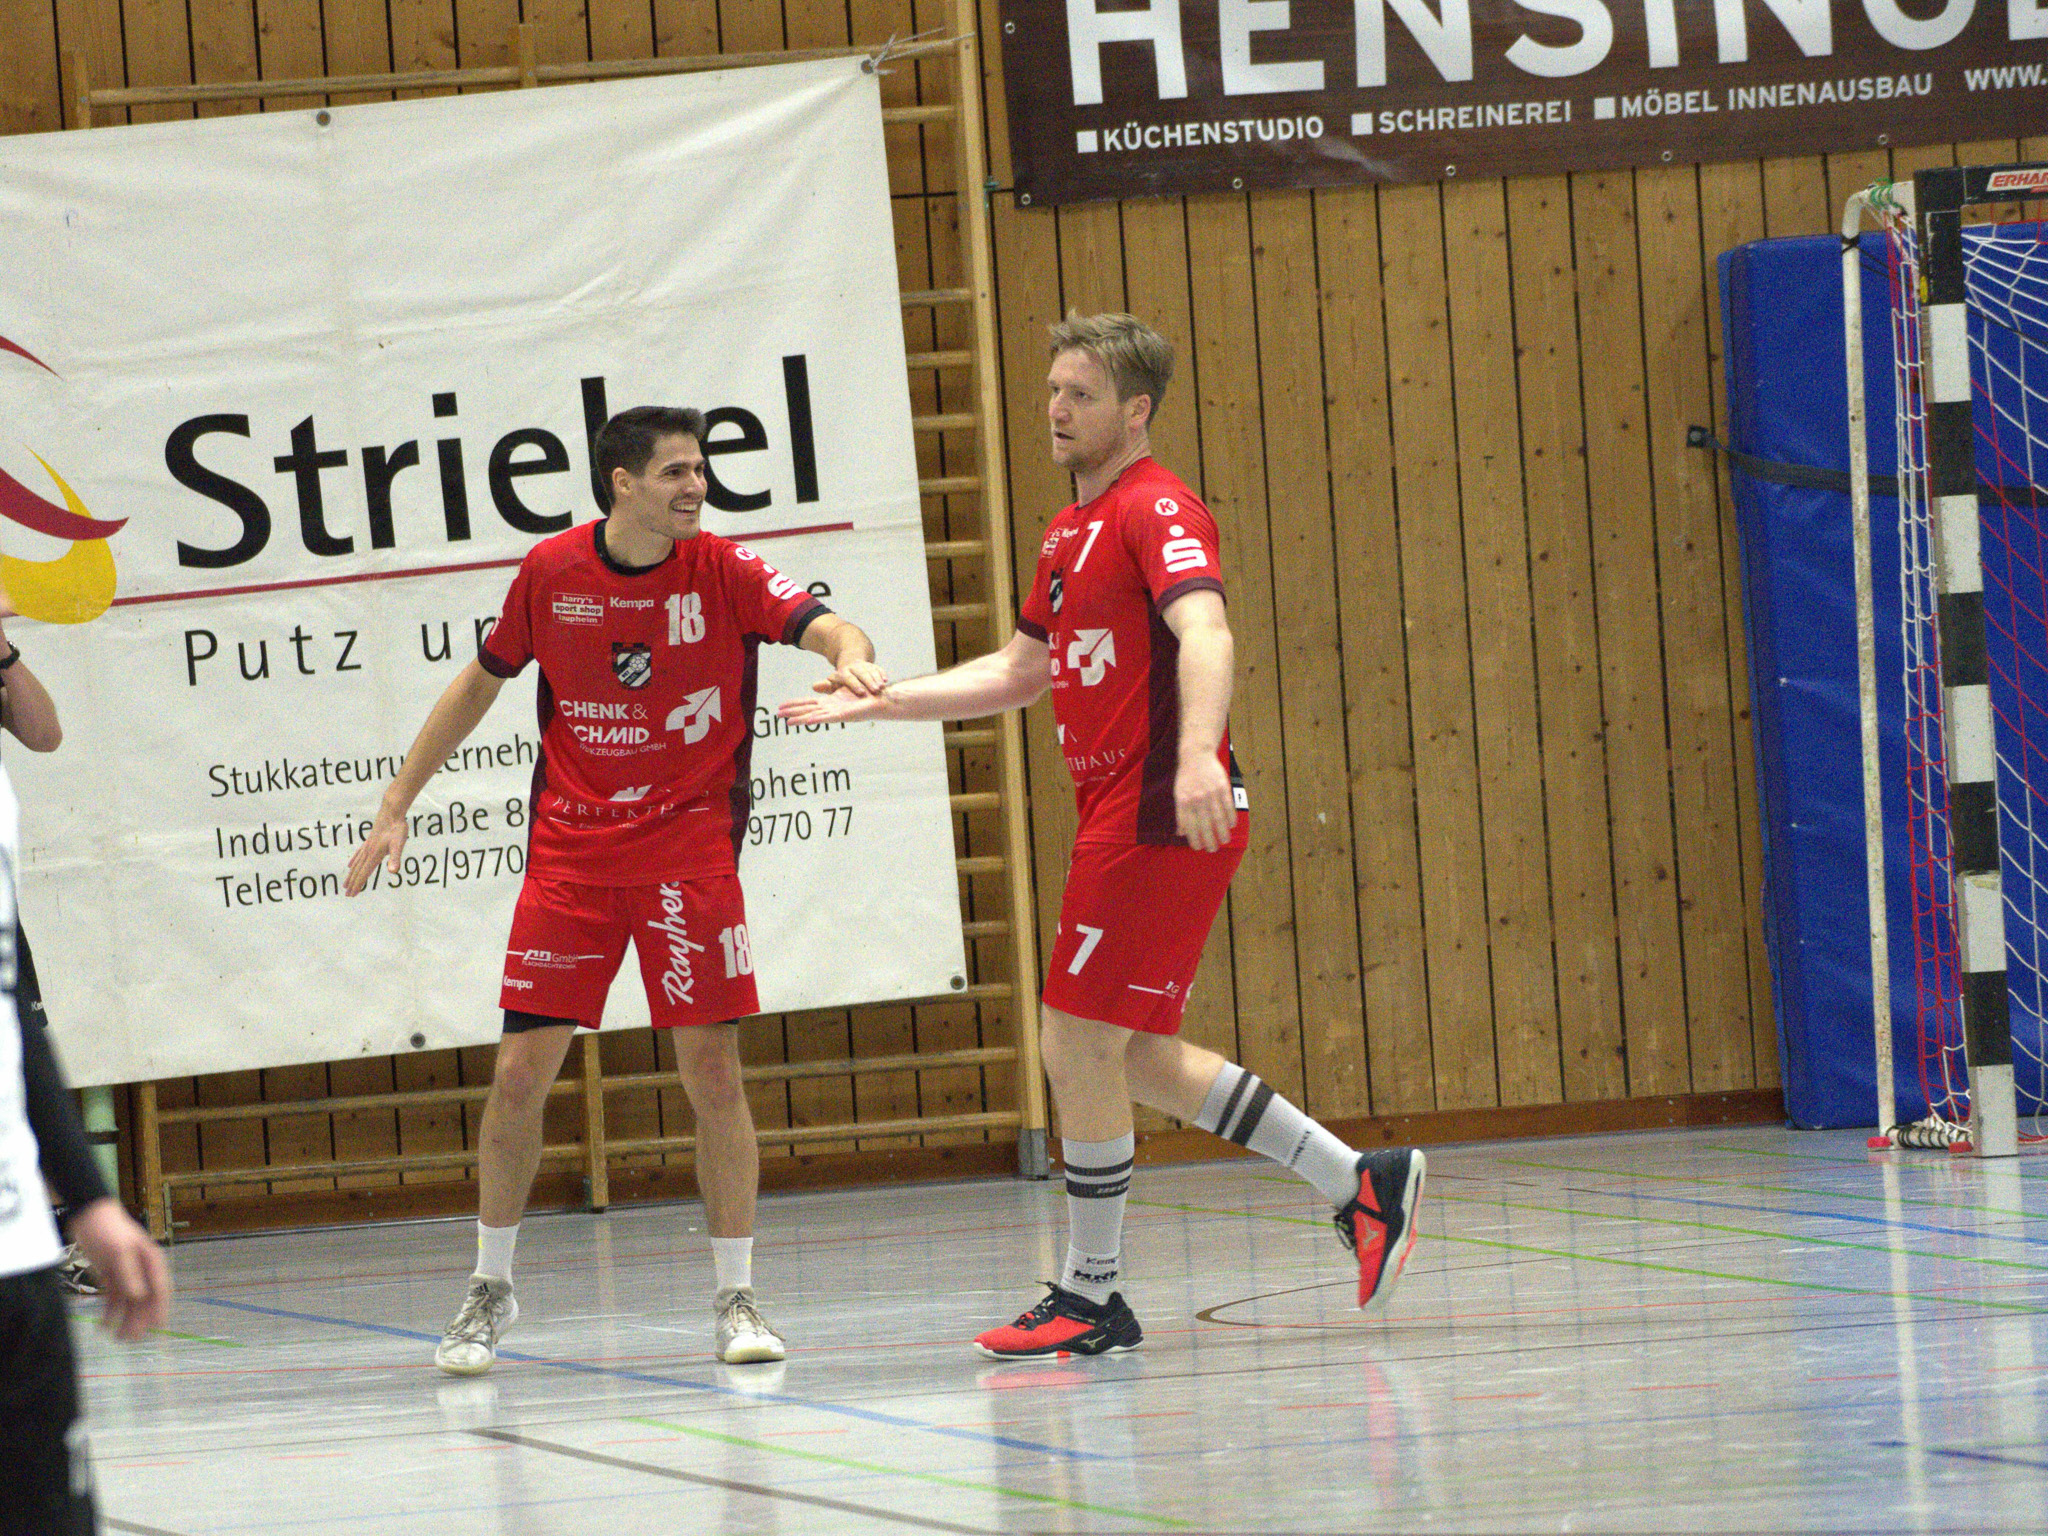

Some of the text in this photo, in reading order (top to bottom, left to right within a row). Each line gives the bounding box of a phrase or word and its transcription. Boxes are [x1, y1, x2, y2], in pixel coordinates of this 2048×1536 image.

[1067, 0, 2048, 105] HENSI
[1103, 115, 1325, 152] KÜCHENSTUDIO
[1379, 100, 1571, 133] SCHREINEREI
[1622, 88, 1718, 118] MÖBEL
[1728, 73, 1933, 111] INNENAUSBAU
[555, 604, 601, 615] sport shop
[559, 615, 598, 624] laupheim
[562, 595, 593, 604] harry's
[610, 597, 654, 610] Kempa
[664, 592, 706, 646] 18
[184, 624, 362, 686] Putz
[568, 723, 650, 744] CHMID
[632, 704, 648, 719] &
[216, 801, 489, 859] Industrieraße
[505, 798, 525, 827] 8
[216, 869, 338, 907] Telefon
[749, 810, 812, 845] 9770
[823, 806, 852, 838] 77
[719, 924, 753, 978] 18
[1067, 923, 1104, 975] 7
